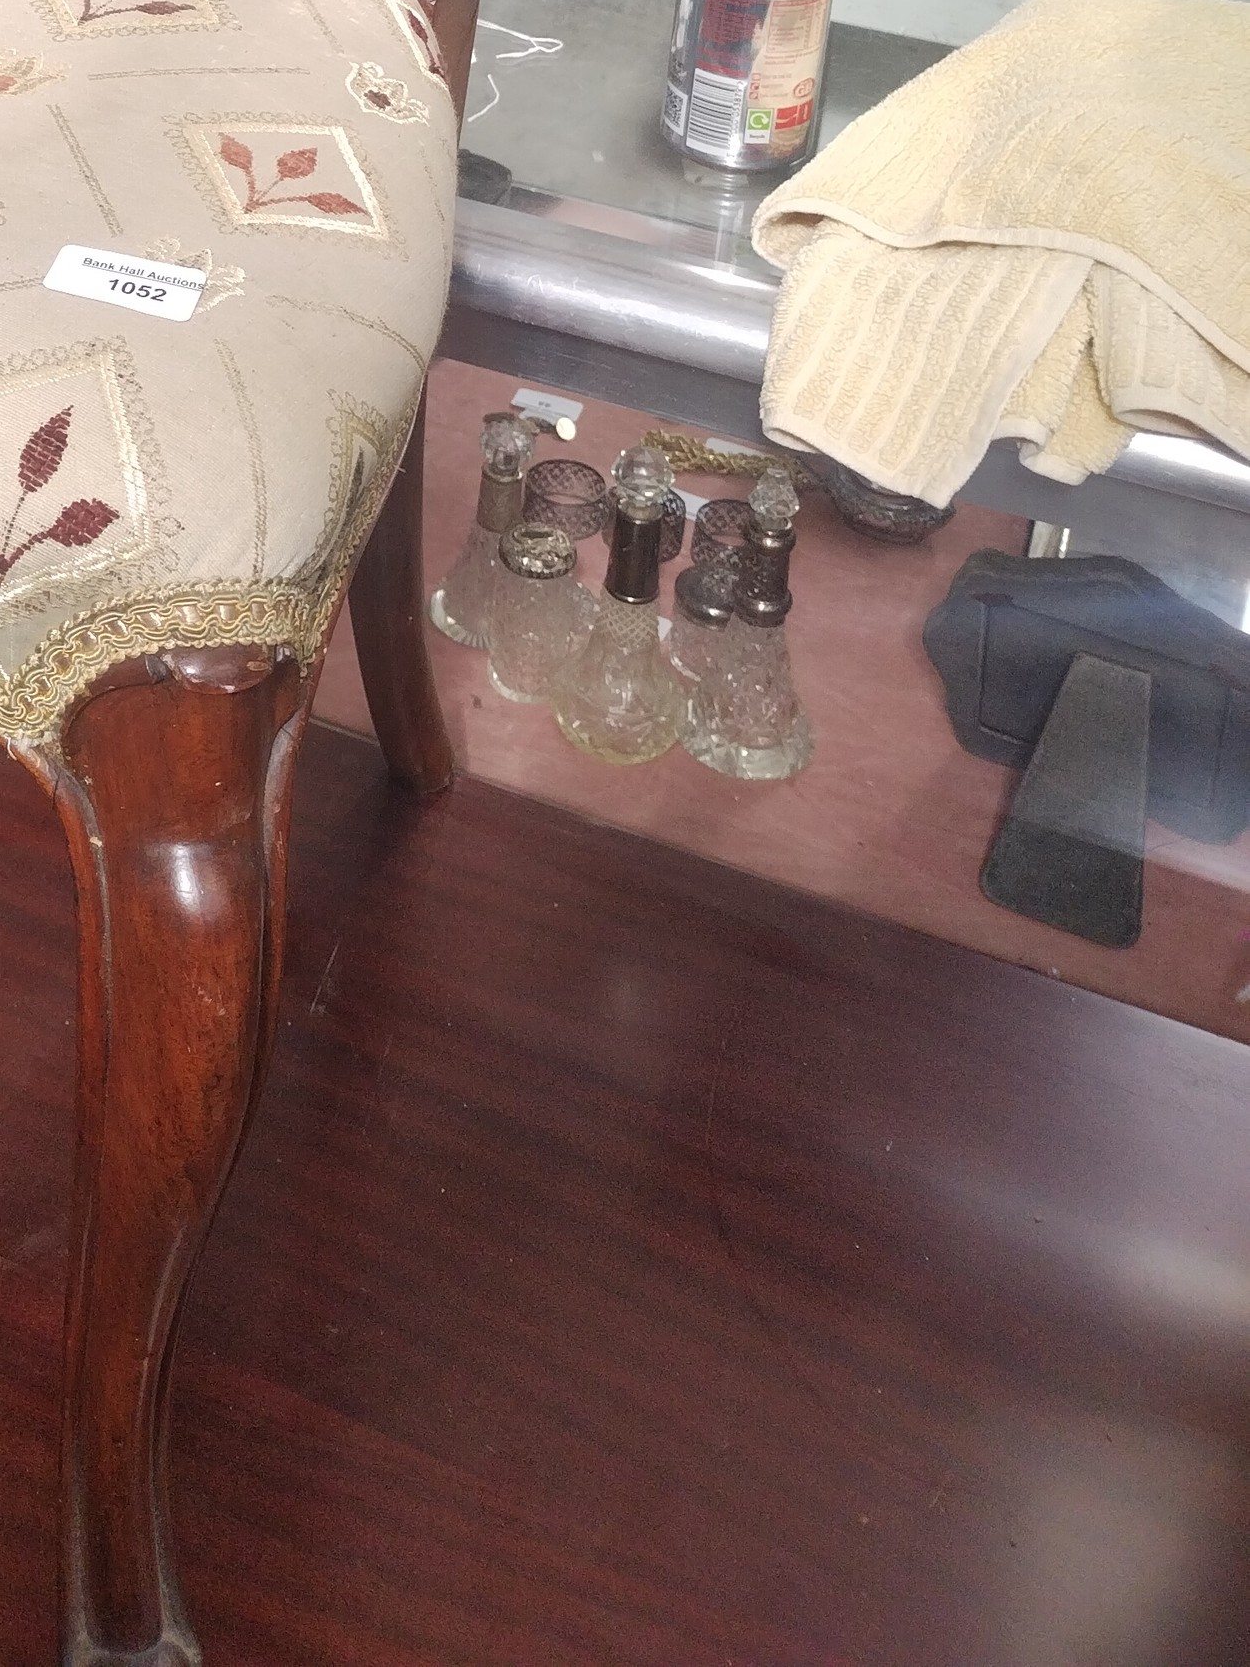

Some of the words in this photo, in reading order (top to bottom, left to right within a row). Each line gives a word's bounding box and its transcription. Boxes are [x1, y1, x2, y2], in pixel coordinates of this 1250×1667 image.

[82, 256, 116, 271] Bank
[119, 264, 144, 276] Hall
[147, 271, 205, 291] Auctions
[108, 278, 168, 303] 1052
